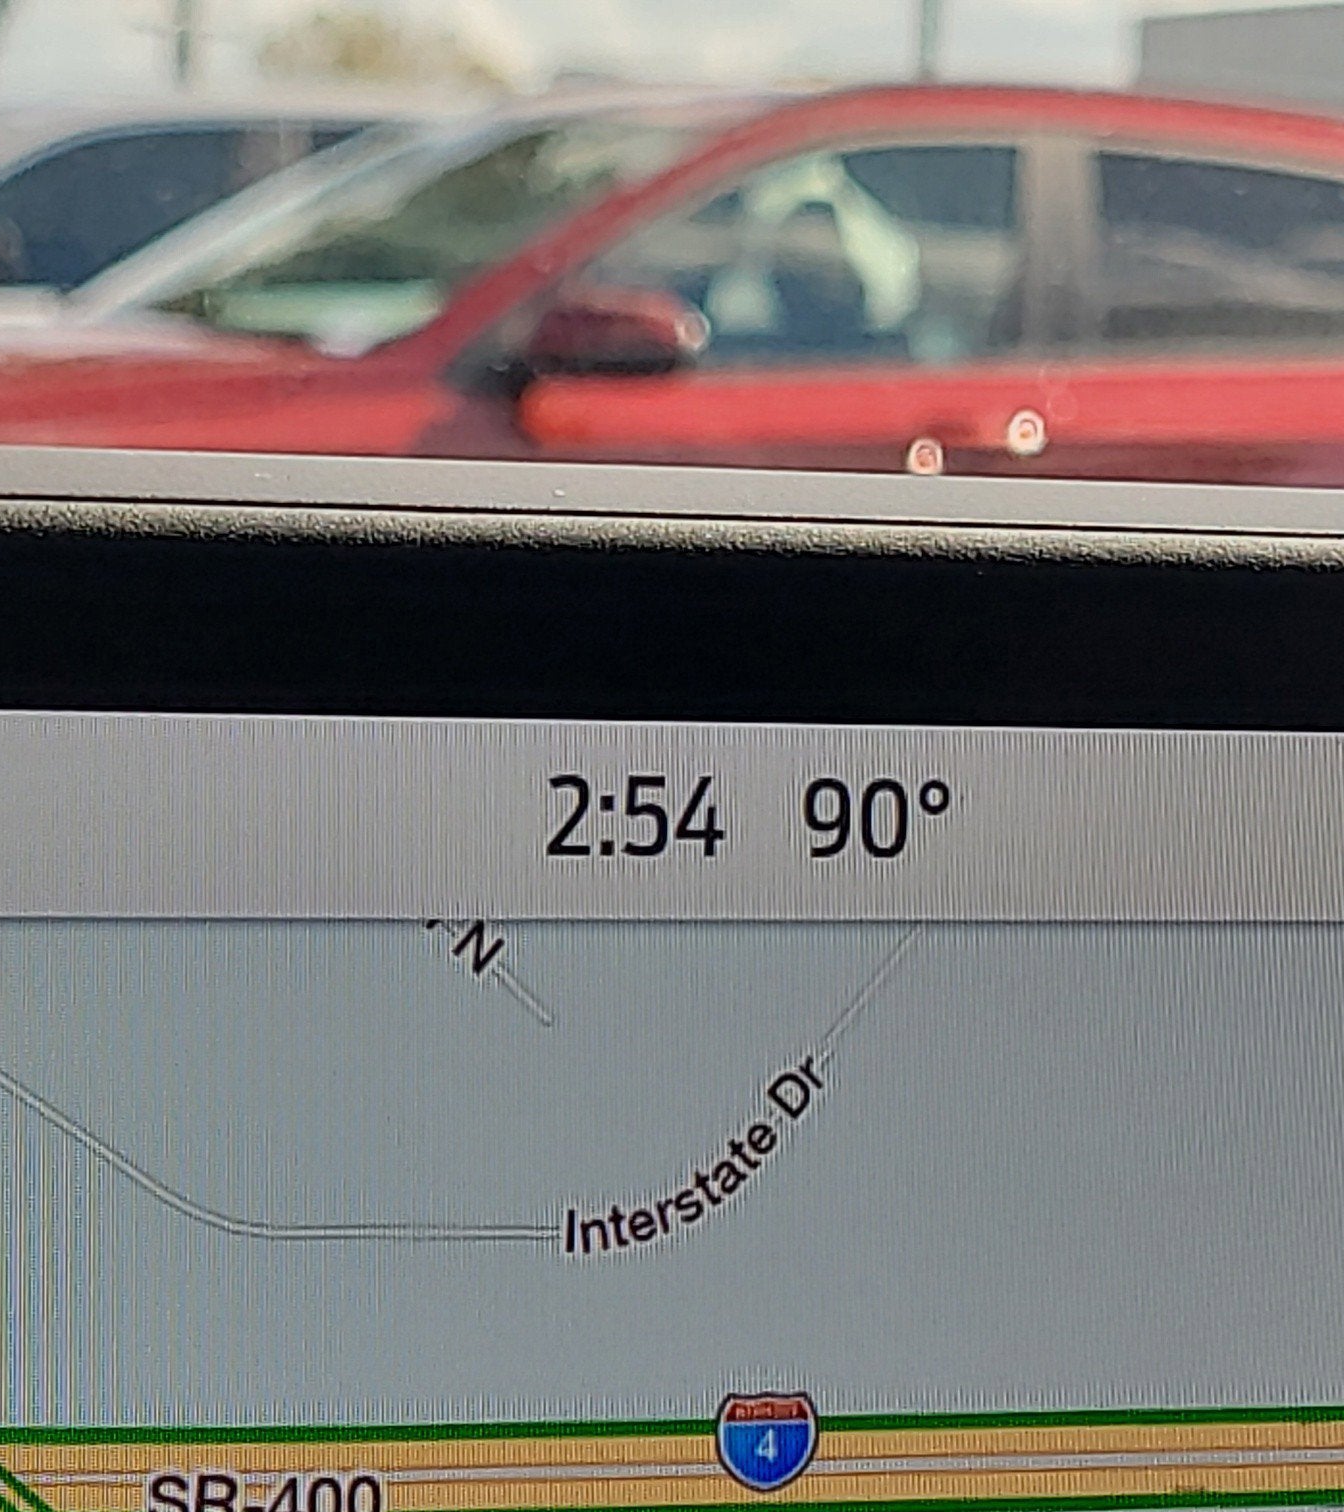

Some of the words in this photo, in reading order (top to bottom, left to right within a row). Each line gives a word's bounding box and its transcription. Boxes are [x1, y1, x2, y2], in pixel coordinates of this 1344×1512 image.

[545, 773, 725, 858] 2:54
[451, 918, 505, 977] N
[565, 1121, 778, 1253] Interstate
[767, 1056, 823, 1119] Dr
[754, 1427, 778, 1464] 4
